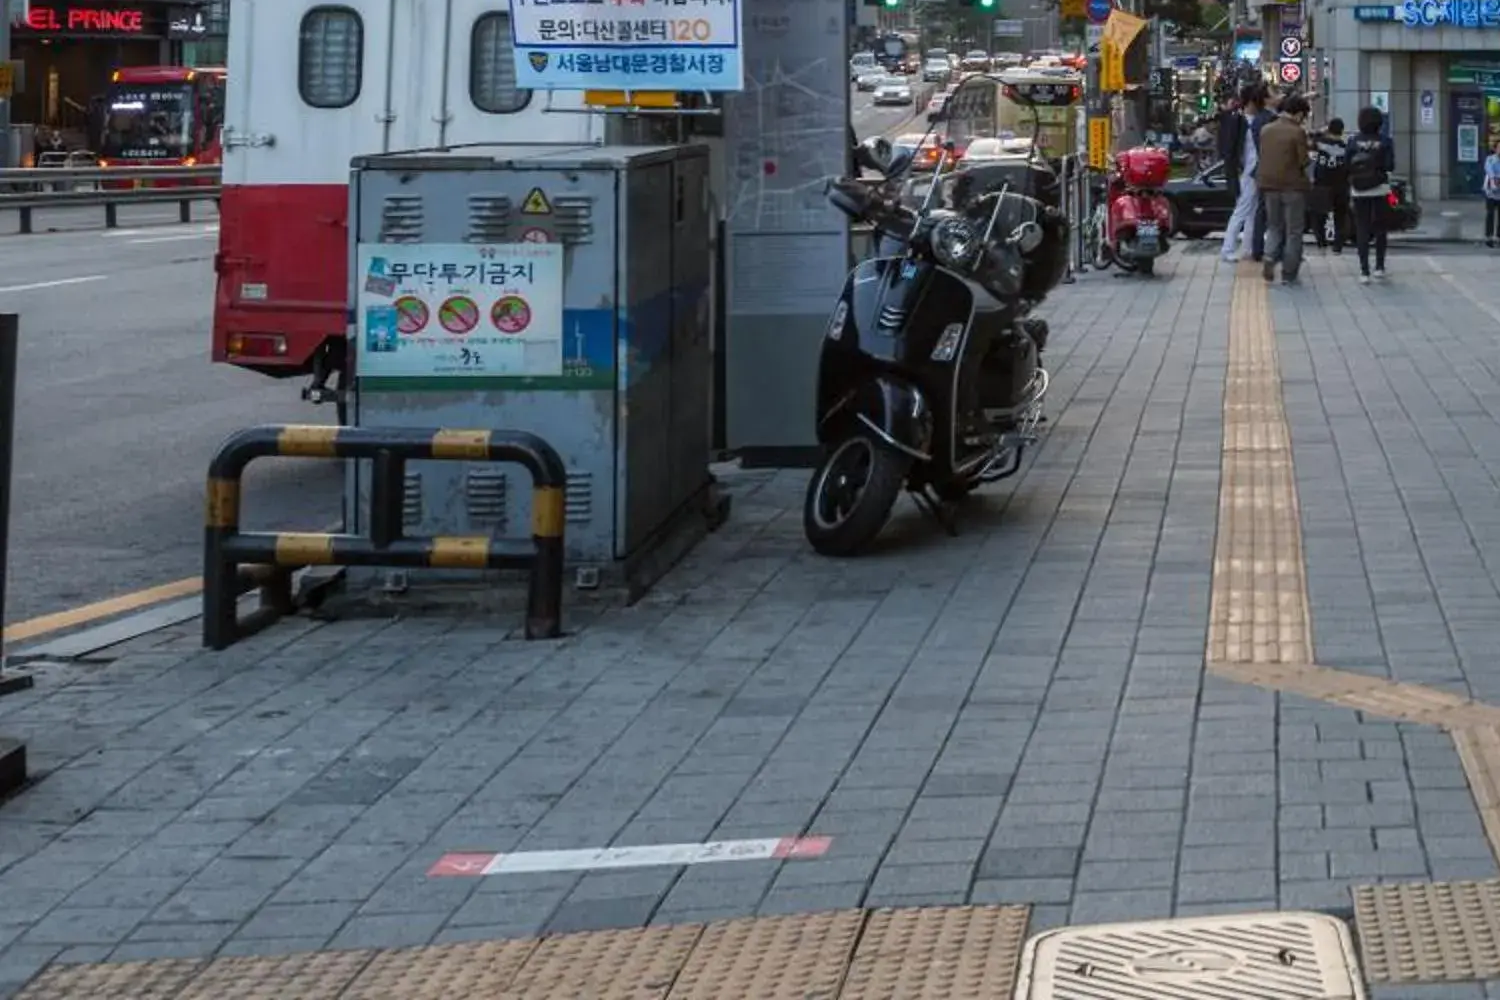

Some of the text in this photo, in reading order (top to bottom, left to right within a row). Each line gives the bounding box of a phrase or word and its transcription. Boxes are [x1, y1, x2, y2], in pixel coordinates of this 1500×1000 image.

[68, 8, 144, 30] PRINCE
[556, 52, 726, 75] 서울남대문경찰서장
[388, 261, 534, 285] 무단투기금지
